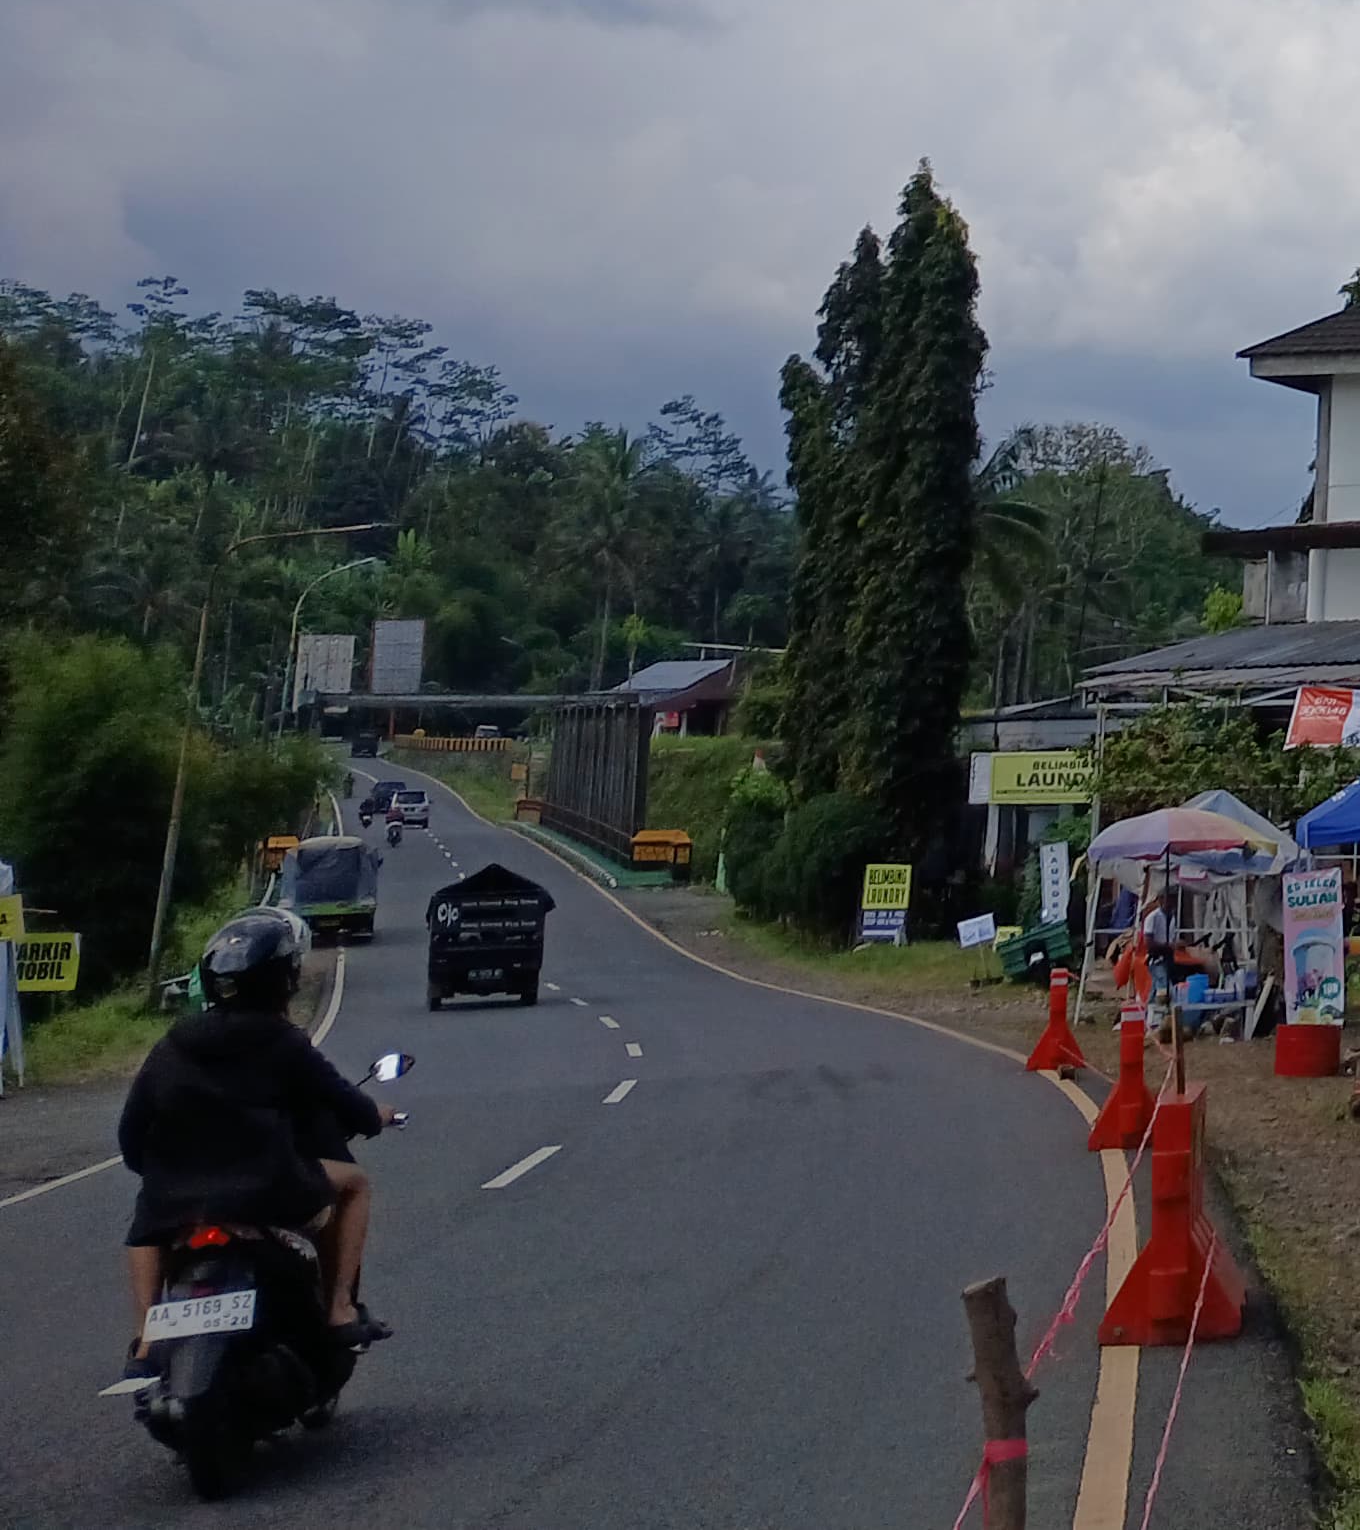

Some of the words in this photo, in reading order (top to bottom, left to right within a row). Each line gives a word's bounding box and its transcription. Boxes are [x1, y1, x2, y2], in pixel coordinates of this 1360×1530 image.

[867, 887, 906, 904] LAUNDRY
[1288, 891, 1338, 908] SULTAN
[16, 941, 72, 962] ARKIR
[150, 1308, 170, 1323] AA
